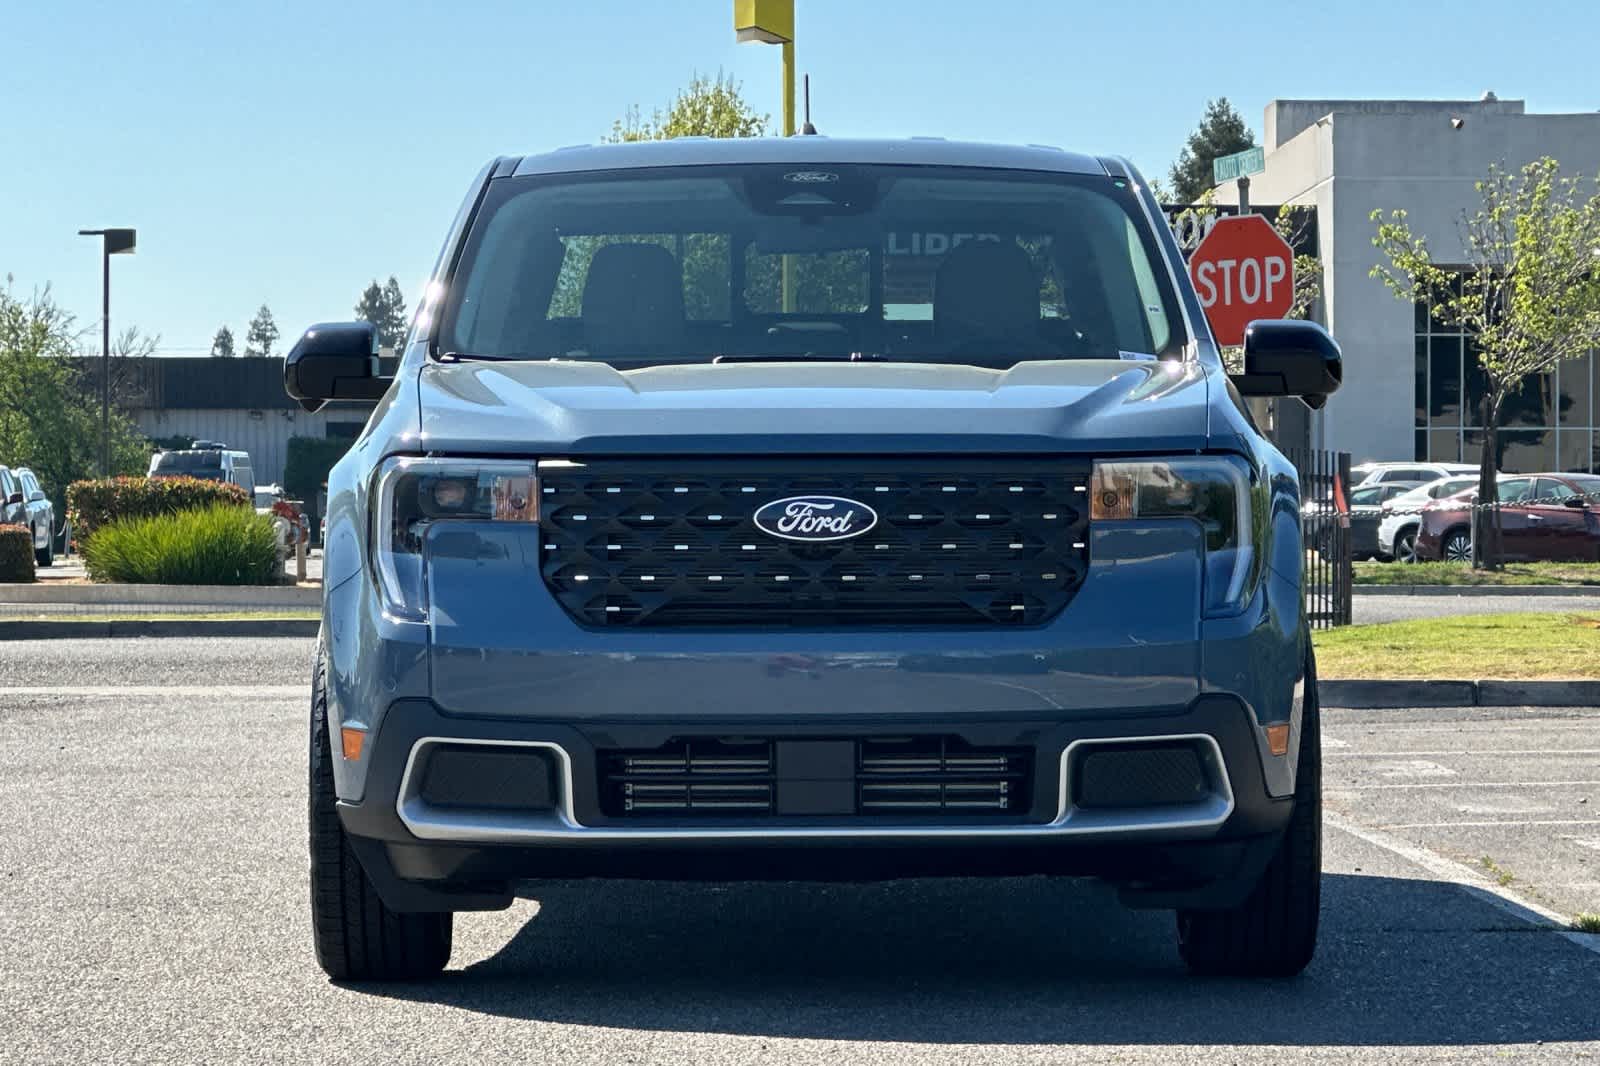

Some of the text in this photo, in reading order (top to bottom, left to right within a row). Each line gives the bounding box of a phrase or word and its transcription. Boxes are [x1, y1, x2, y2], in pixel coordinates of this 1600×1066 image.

[792, 172, 832, 183] Ford
[1197, 256, 1286, 308] STOP
[777, 501, 853, 532] Ford
